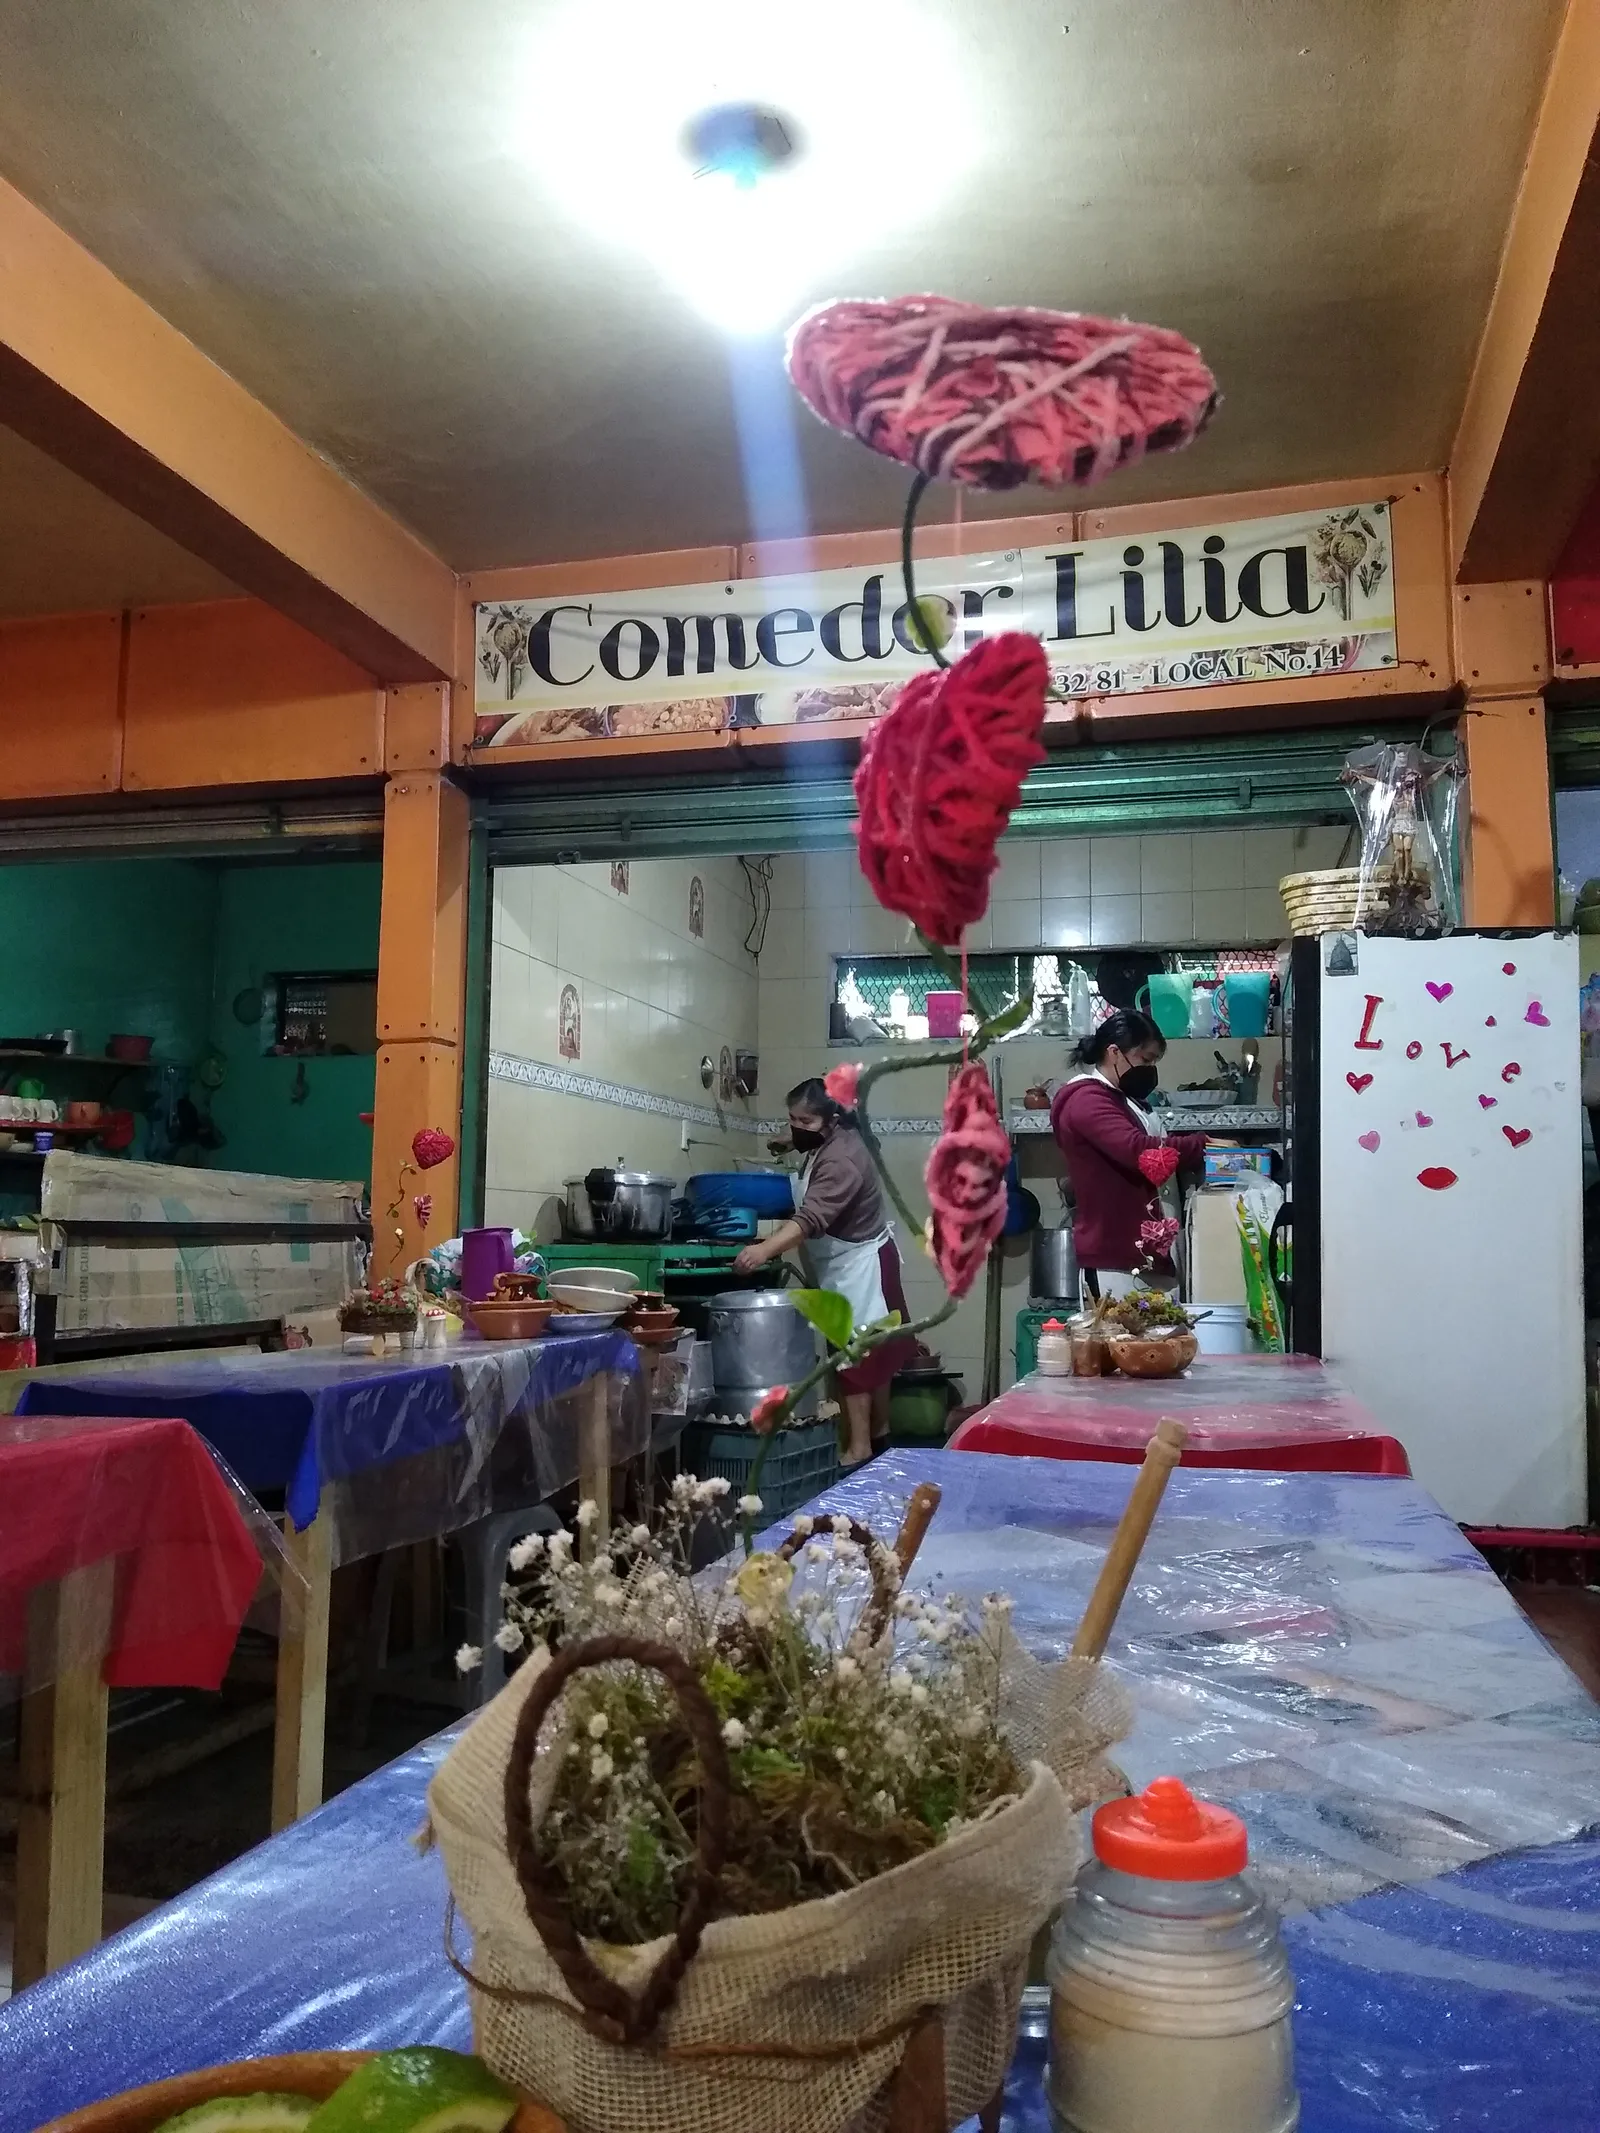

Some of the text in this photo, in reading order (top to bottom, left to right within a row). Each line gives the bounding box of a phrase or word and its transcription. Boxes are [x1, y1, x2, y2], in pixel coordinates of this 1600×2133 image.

[527, 535, 1325, 686] Comedor Lilia
[1097, 668, 1121, 690] 81
[1152, 656, 1253, 685] LOCAL
